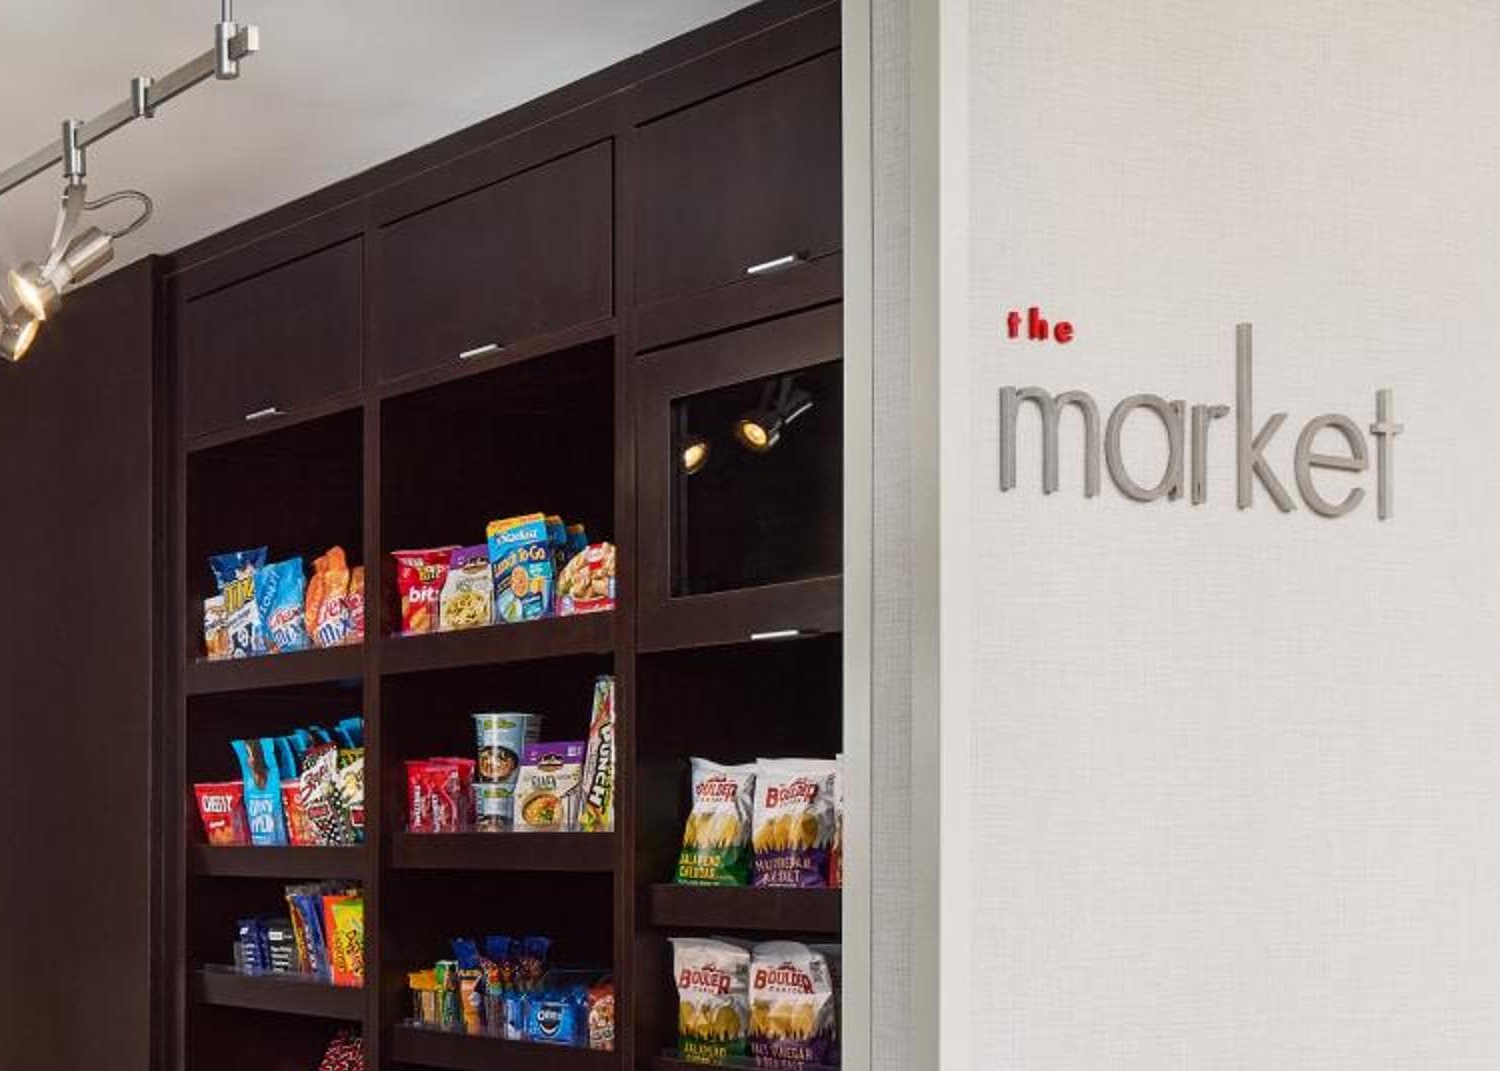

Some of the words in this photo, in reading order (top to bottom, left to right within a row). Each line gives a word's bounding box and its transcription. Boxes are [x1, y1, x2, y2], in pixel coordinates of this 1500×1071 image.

[1006, 306, 1074, 344] the
[998, 321, 1404, 521] market
[753, 969, 816, 994] BOULDER
